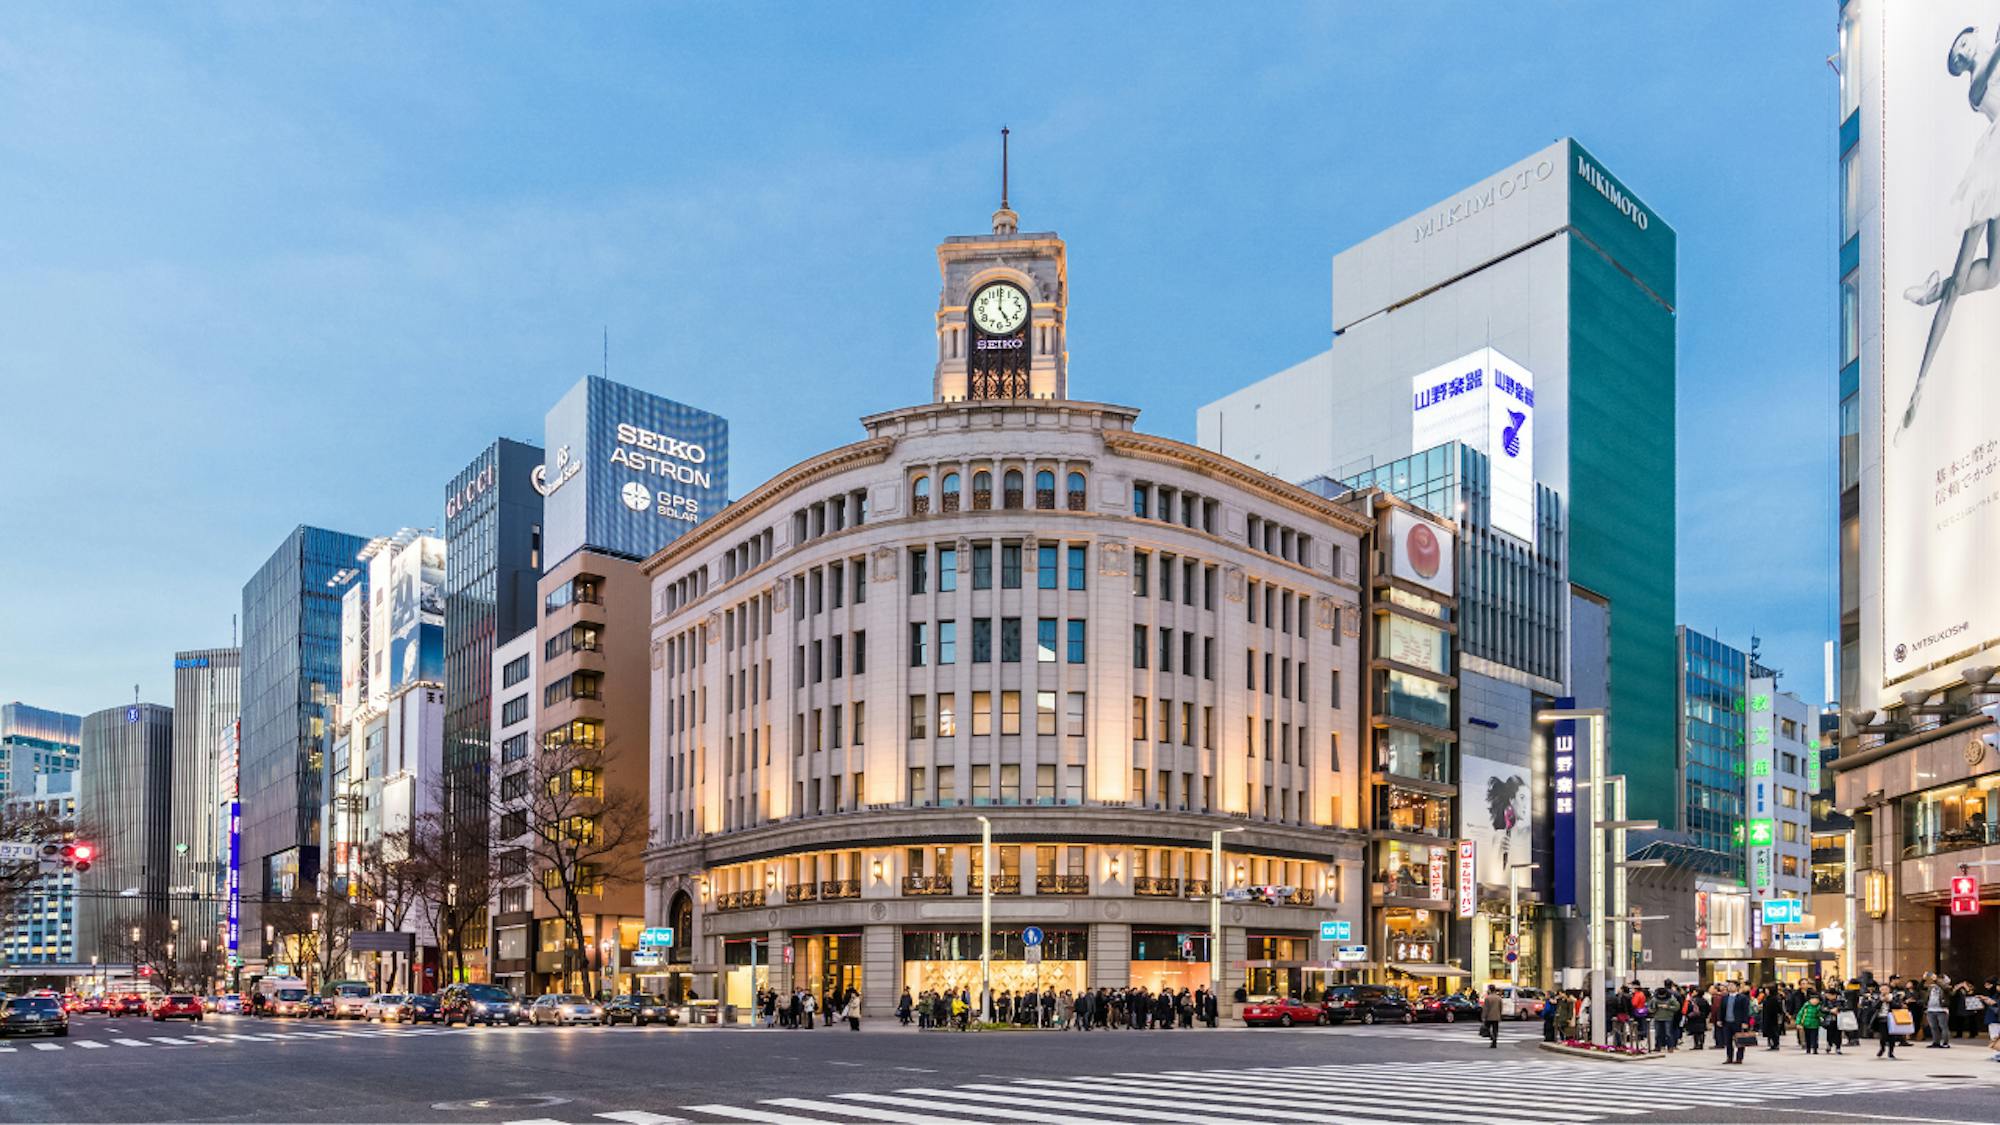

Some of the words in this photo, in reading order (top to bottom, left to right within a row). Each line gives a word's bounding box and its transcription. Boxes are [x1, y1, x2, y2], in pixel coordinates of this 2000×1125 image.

[1414, 160, 1554, 243] MIKIMOTO
[1578, 156, 1648, 230] MIKIMOTO
[977, 339, 1023, 350] SEIKO
[1414, 368, 1483, 411] 山野楽器
[617, 423, 706, 464] SEIKO
[610, 447, 711, 490] ASTRON
[446, 464, 493, 519] GUCCI
[656, 491, 699, 514] GPS
[656, 505, 699, 524] SOLAR
